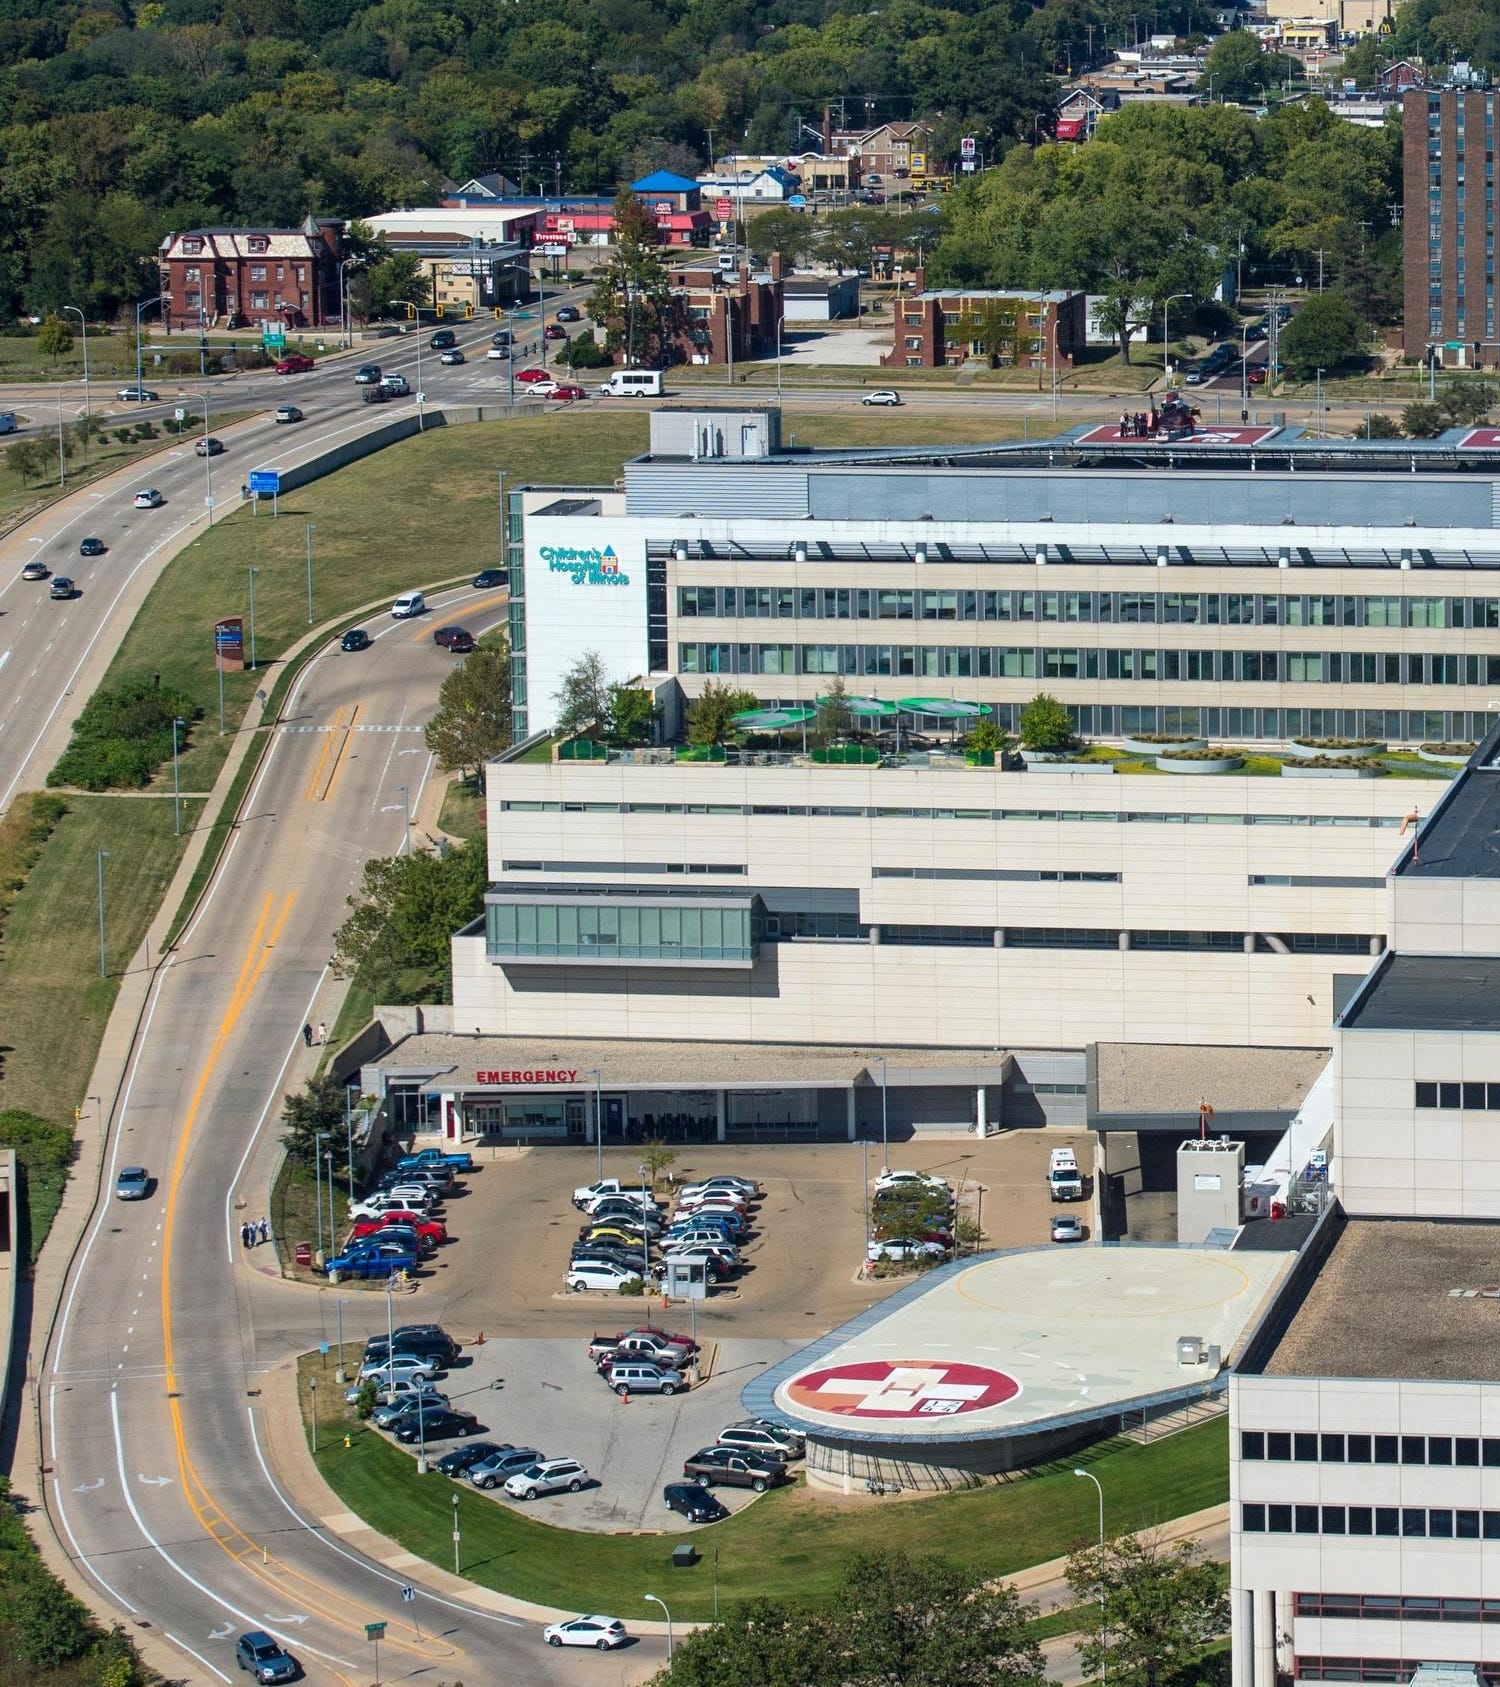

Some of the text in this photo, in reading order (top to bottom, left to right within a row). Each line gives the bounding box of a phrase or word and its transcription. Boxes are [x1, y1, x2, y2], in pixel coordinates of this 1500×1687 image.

[535, 233, 567, 241] Firestone
[539, 546, 602, 560] Children's
[549, 559, 602, 573] Hospital
[571, 571, 630, 586] of Illinois
[476, 1069, 577, 1083] EMERGENCY
[879, 1382, 926, 1397] H
